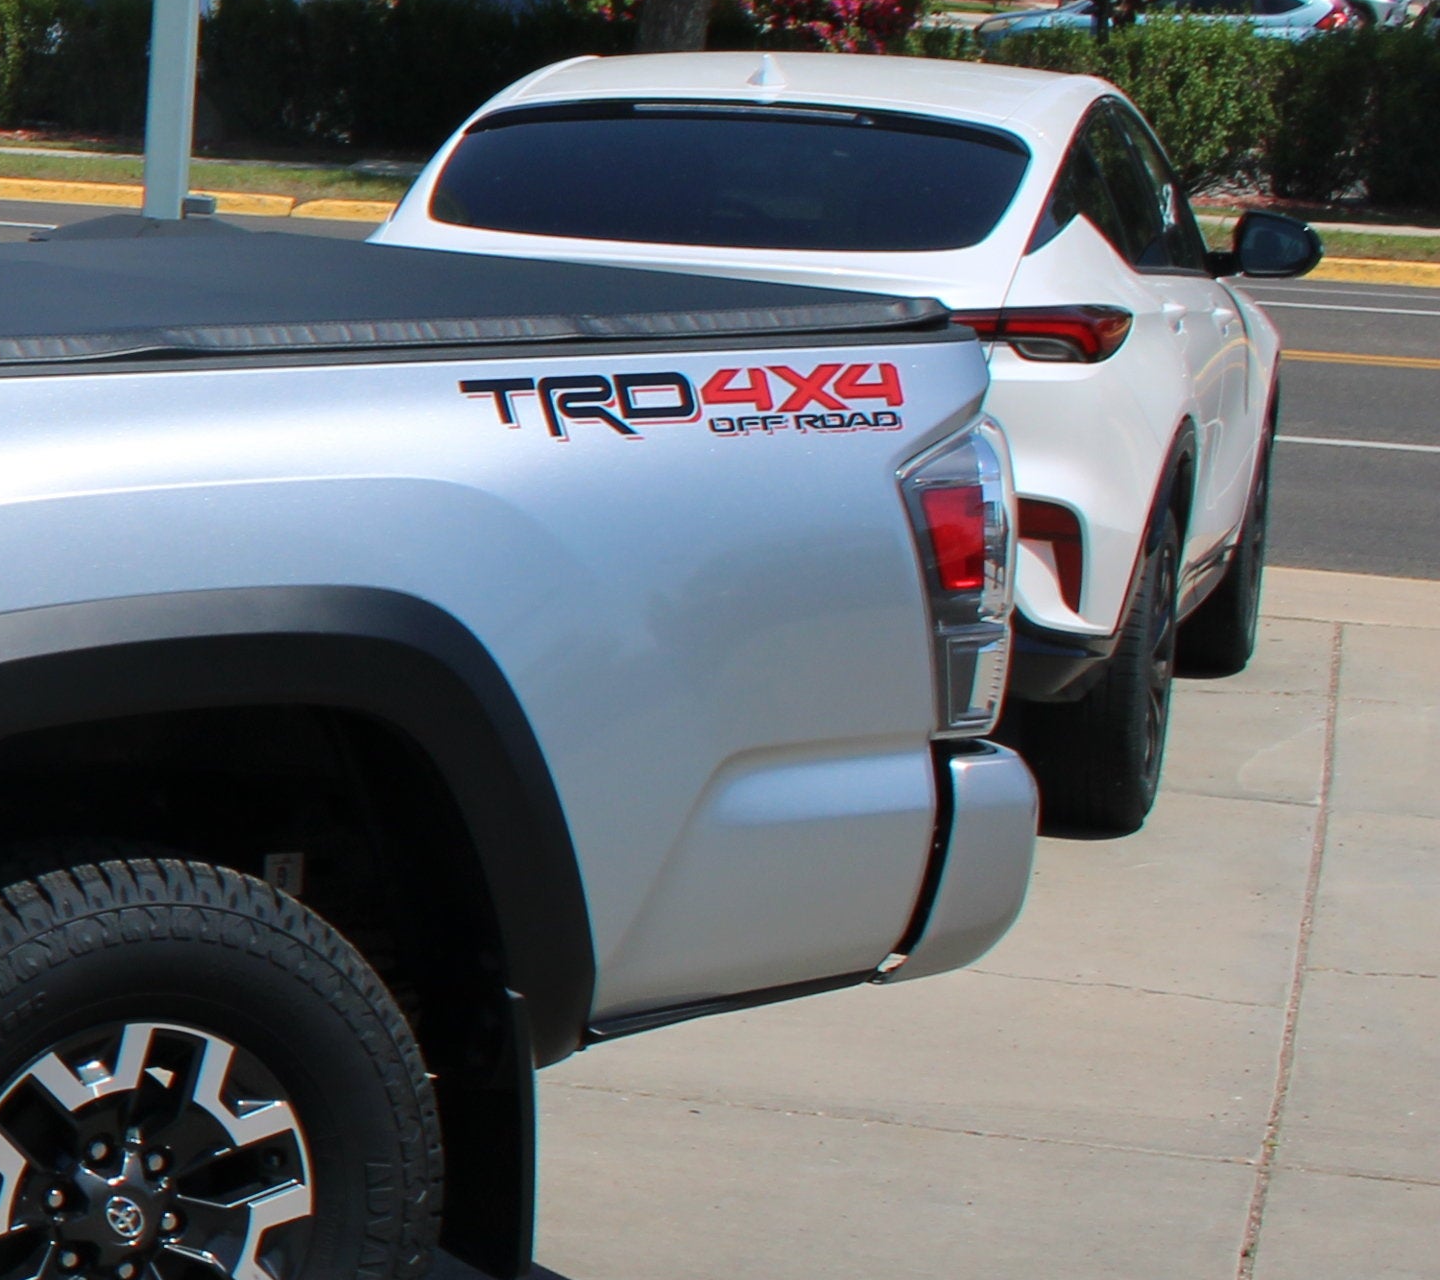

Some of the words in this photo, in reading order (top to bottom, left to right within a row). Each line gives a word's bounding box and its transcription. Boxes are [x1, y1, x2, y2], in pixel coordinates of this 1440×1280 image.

[458, 371, 701, 442] TRD
[700, 362, 904, 413] 4X4
[708, 412, 798, 436] OFF
[793, 409, 904, 434] ROAD
